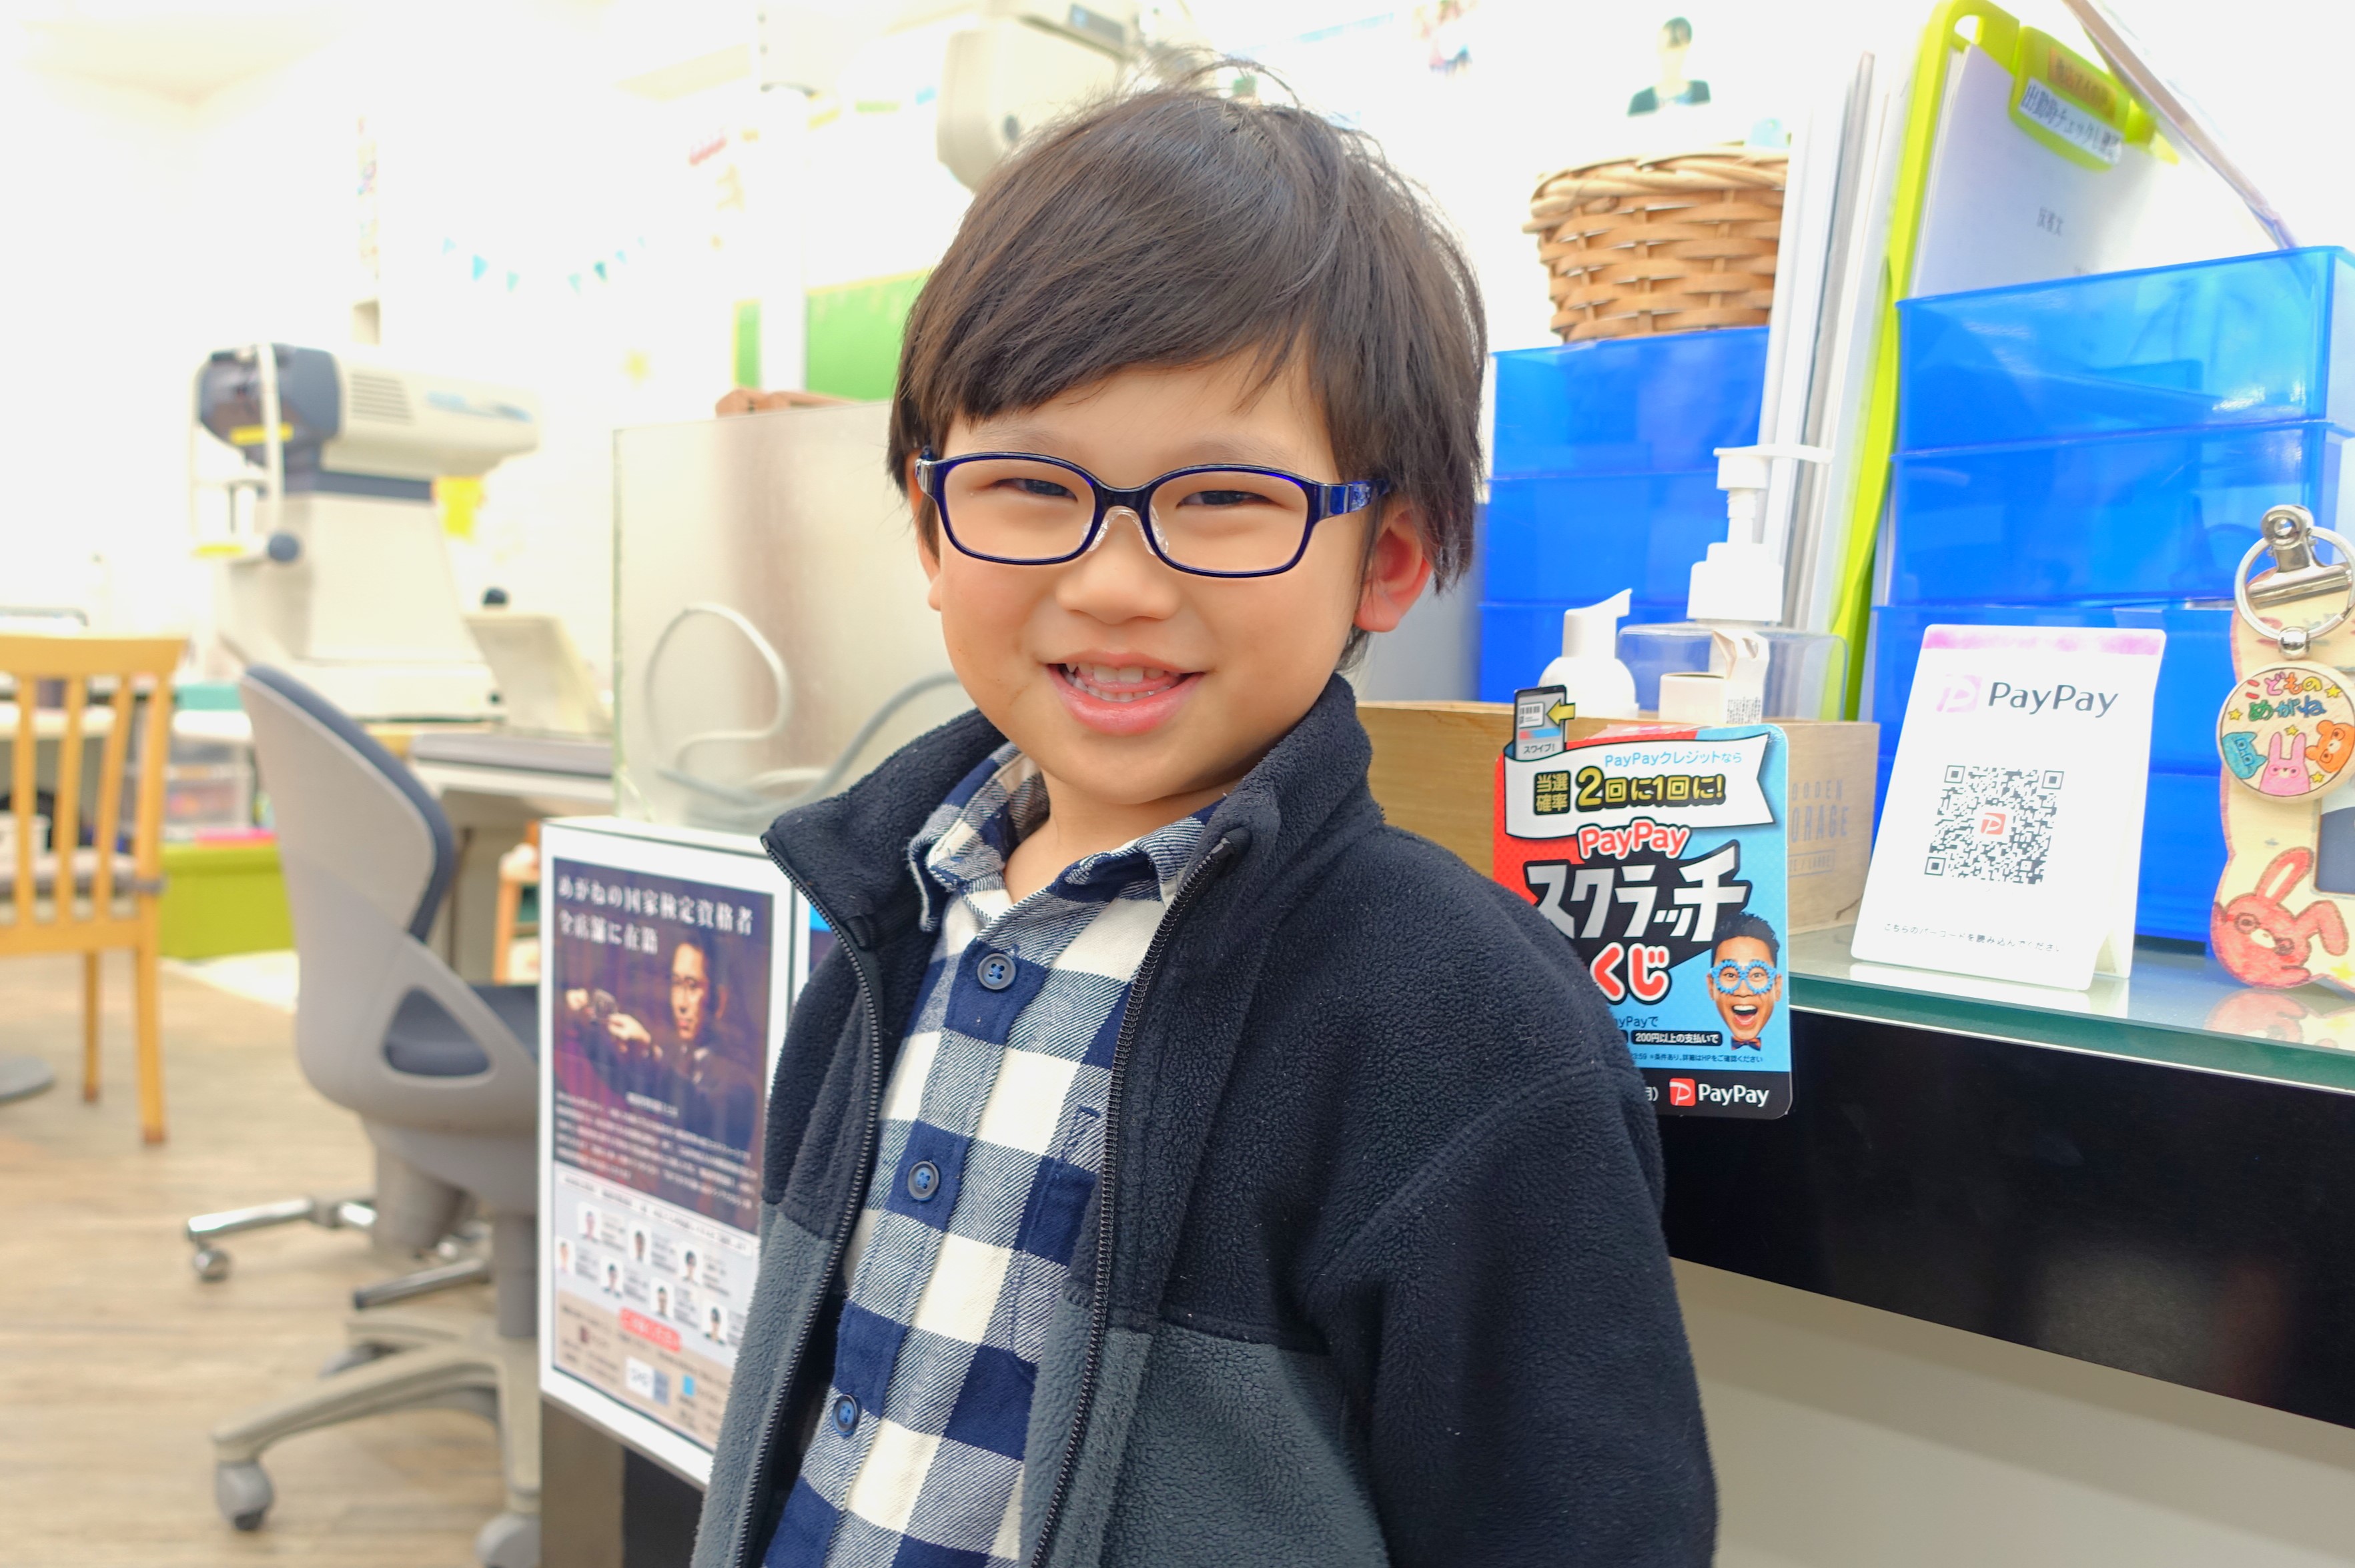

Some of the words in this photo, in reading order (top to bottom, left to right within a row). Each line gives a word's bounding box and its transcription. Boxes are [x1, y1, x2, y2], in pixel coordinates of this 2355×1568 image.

[2245, 671, 2322, 700] こどもの
[1987, 682, 2119, 718] PayPay
[2248, 694, 2327, 722] めがね
[1522, 743, 1556, 754] スワイプ!
[1604, 751, 1742, 768] PayPayクレジットなら
[1536, 773, 1568, 792] 当選
[1791, 779, 1843, 800] OODEN
[1536, 793, 1568, 812] 確率
[1791, 804, 1849, 843] ORAGE
[1580, 821, 1688, 858] PayPay
[1526, 845, 1748, 942] スクラッチ
[1593, 944, 1669, 998] くじ
[1634, 1032, 1719, 1044] 200円以上の支払いで
[1698, 1083, 1770, 1107] PayPay
